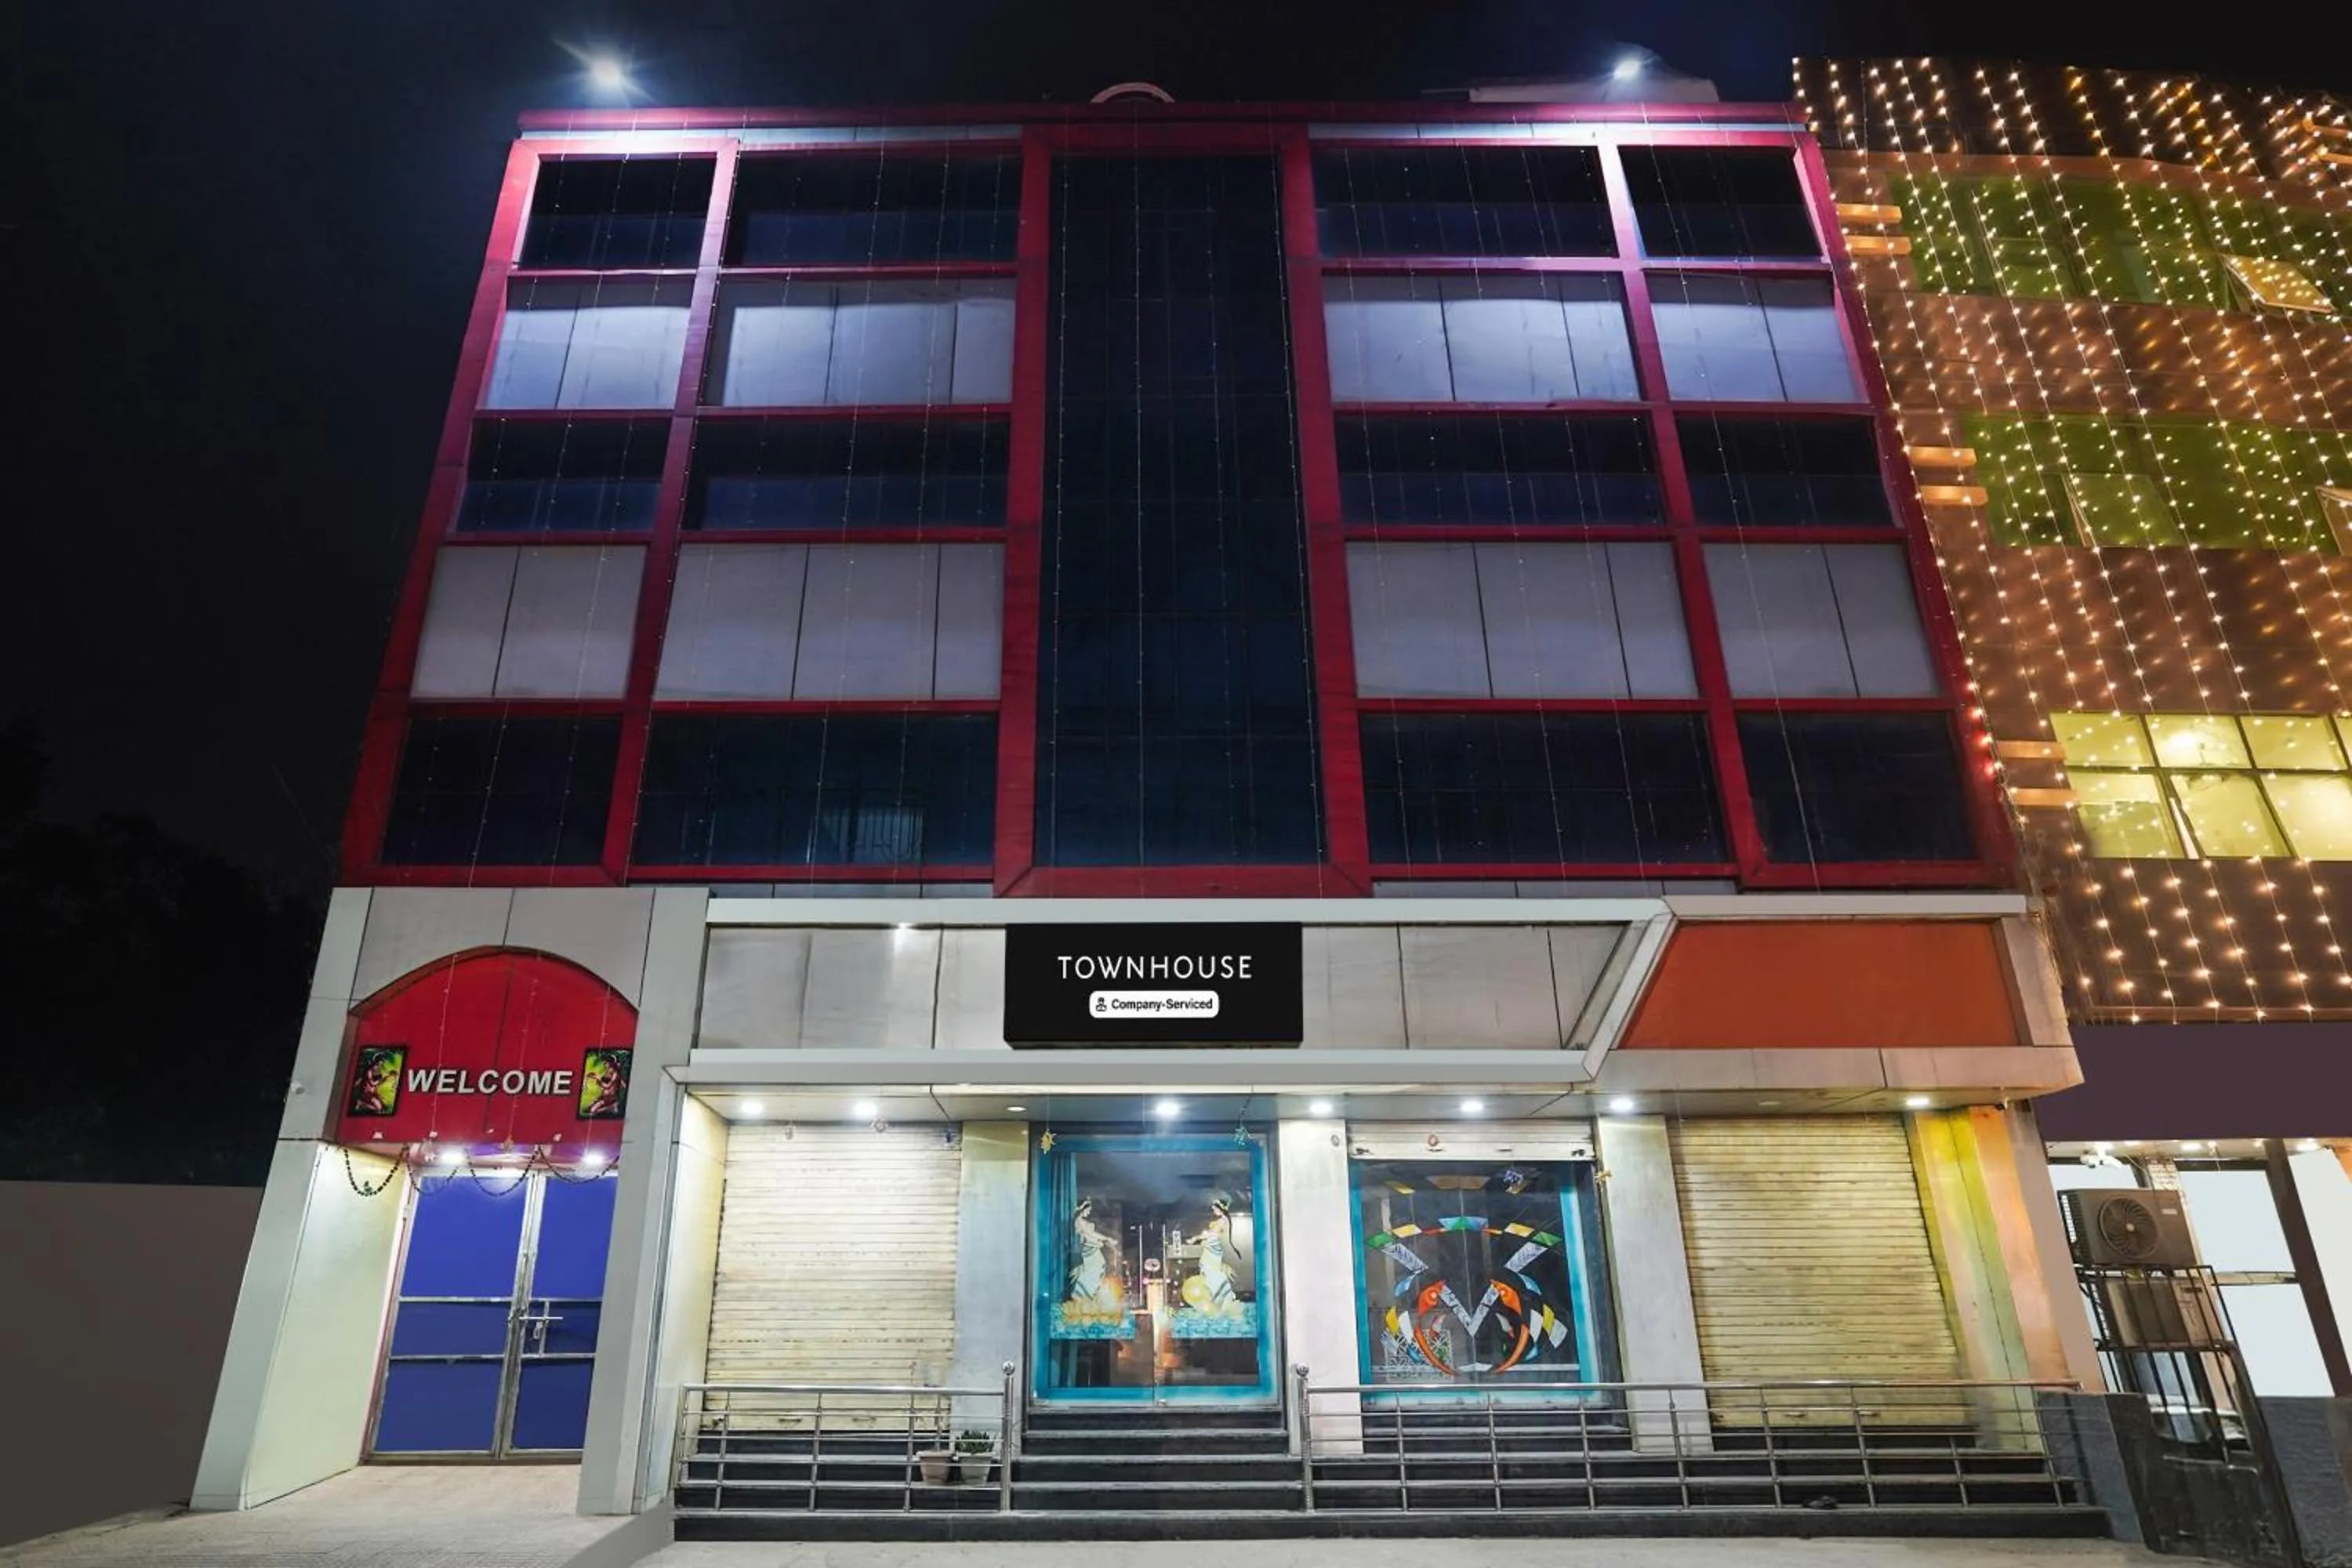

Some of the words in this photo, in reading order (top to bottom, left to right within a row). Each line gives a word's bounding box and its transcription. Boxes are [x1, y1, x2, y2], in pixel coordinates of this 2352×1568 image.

[1058, 955, 1252, 979] TOWNHOUSE
[1111, 998, 1213, 1012] Company-Serviced
[408, 1069, 573, 1094] WELCOME
